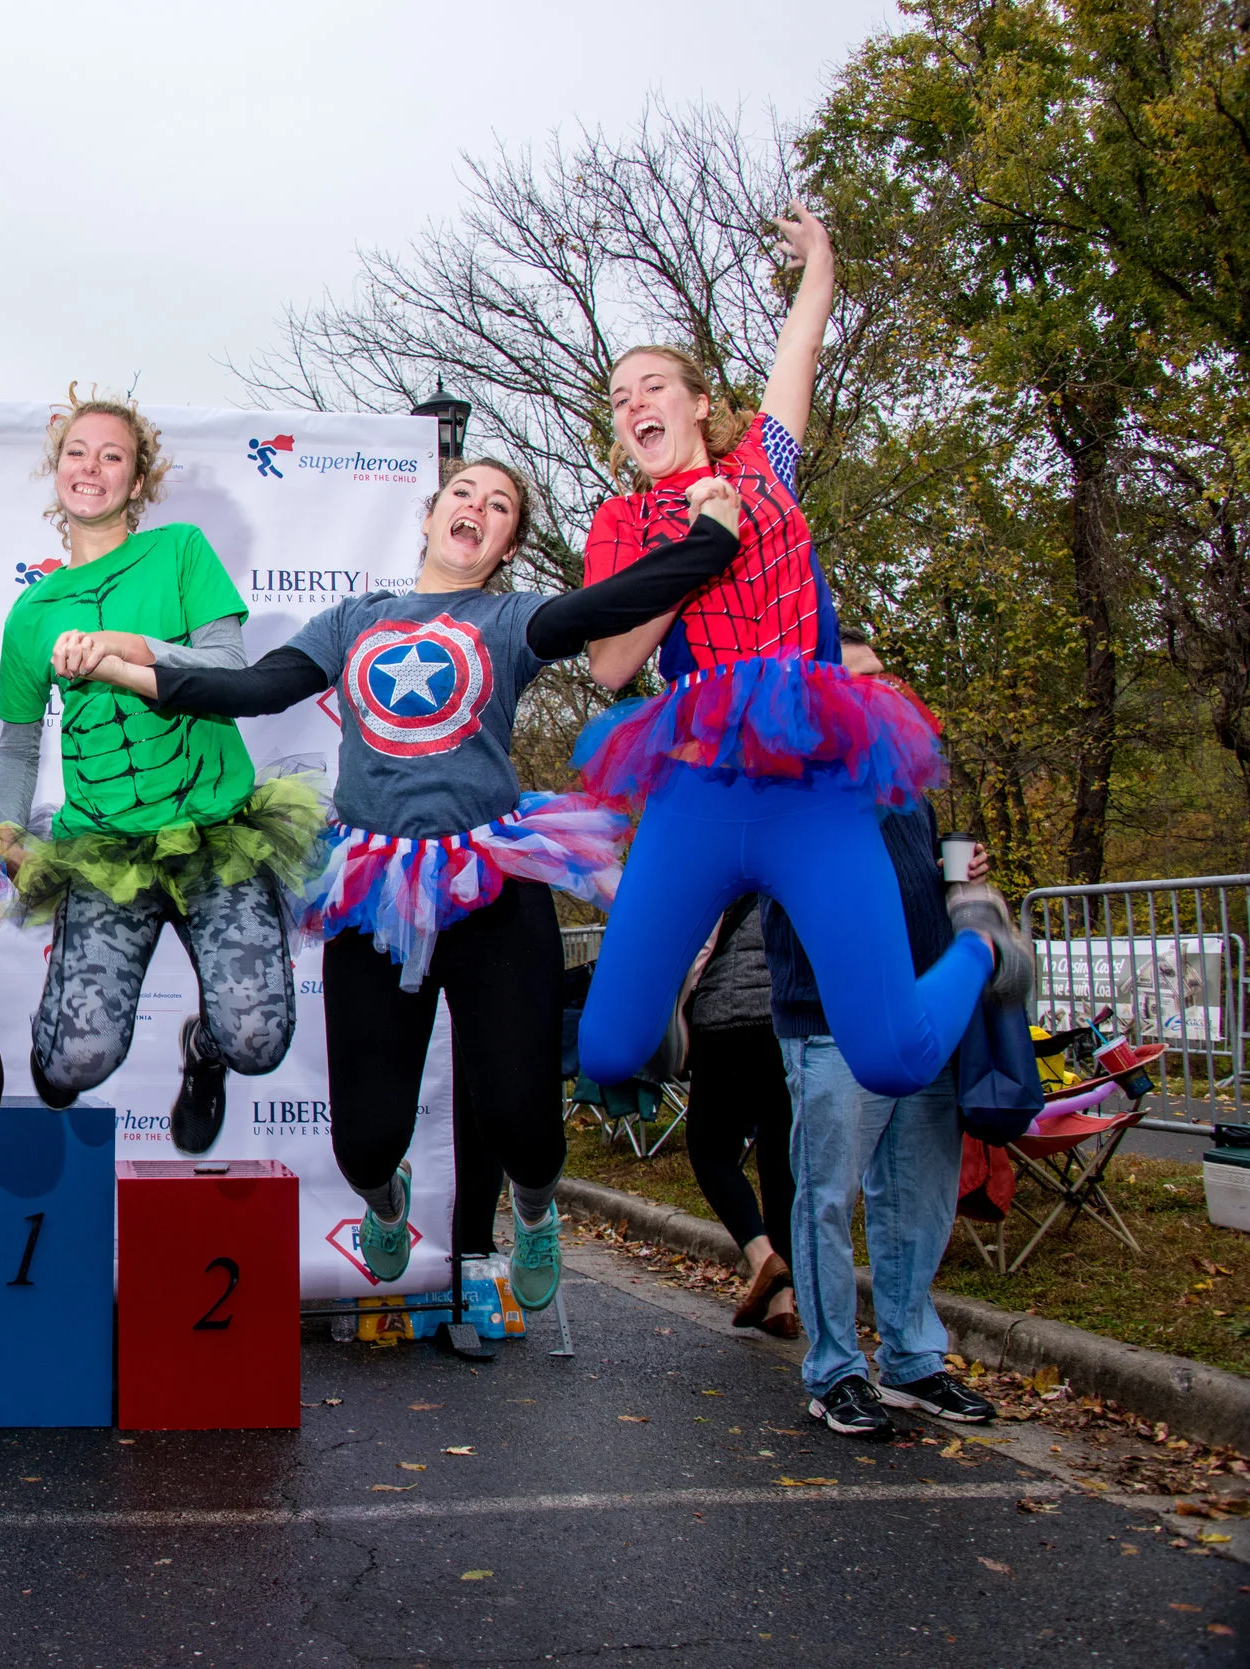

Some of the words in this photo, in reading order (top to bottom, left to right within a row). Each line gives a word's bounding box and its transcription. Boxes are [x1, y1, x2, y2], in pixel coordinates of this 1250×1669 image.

[298, 451, 418, 473] superheroes
[374, 474, 390, 482] THE
[392, 475, 417, 483] CHILD
[251, 569, 361, 592] LIBERTY
[252, 1101, 330, 1123] LIBER
[123, 1133, 141, 1141] FOR
[145, 1133, 162, 1141] THE
[253, 1126, 330, 1136] UNIVERS
[6, 1212, 45, 1286] 1
[192, 1256, 241, 1331] 2
